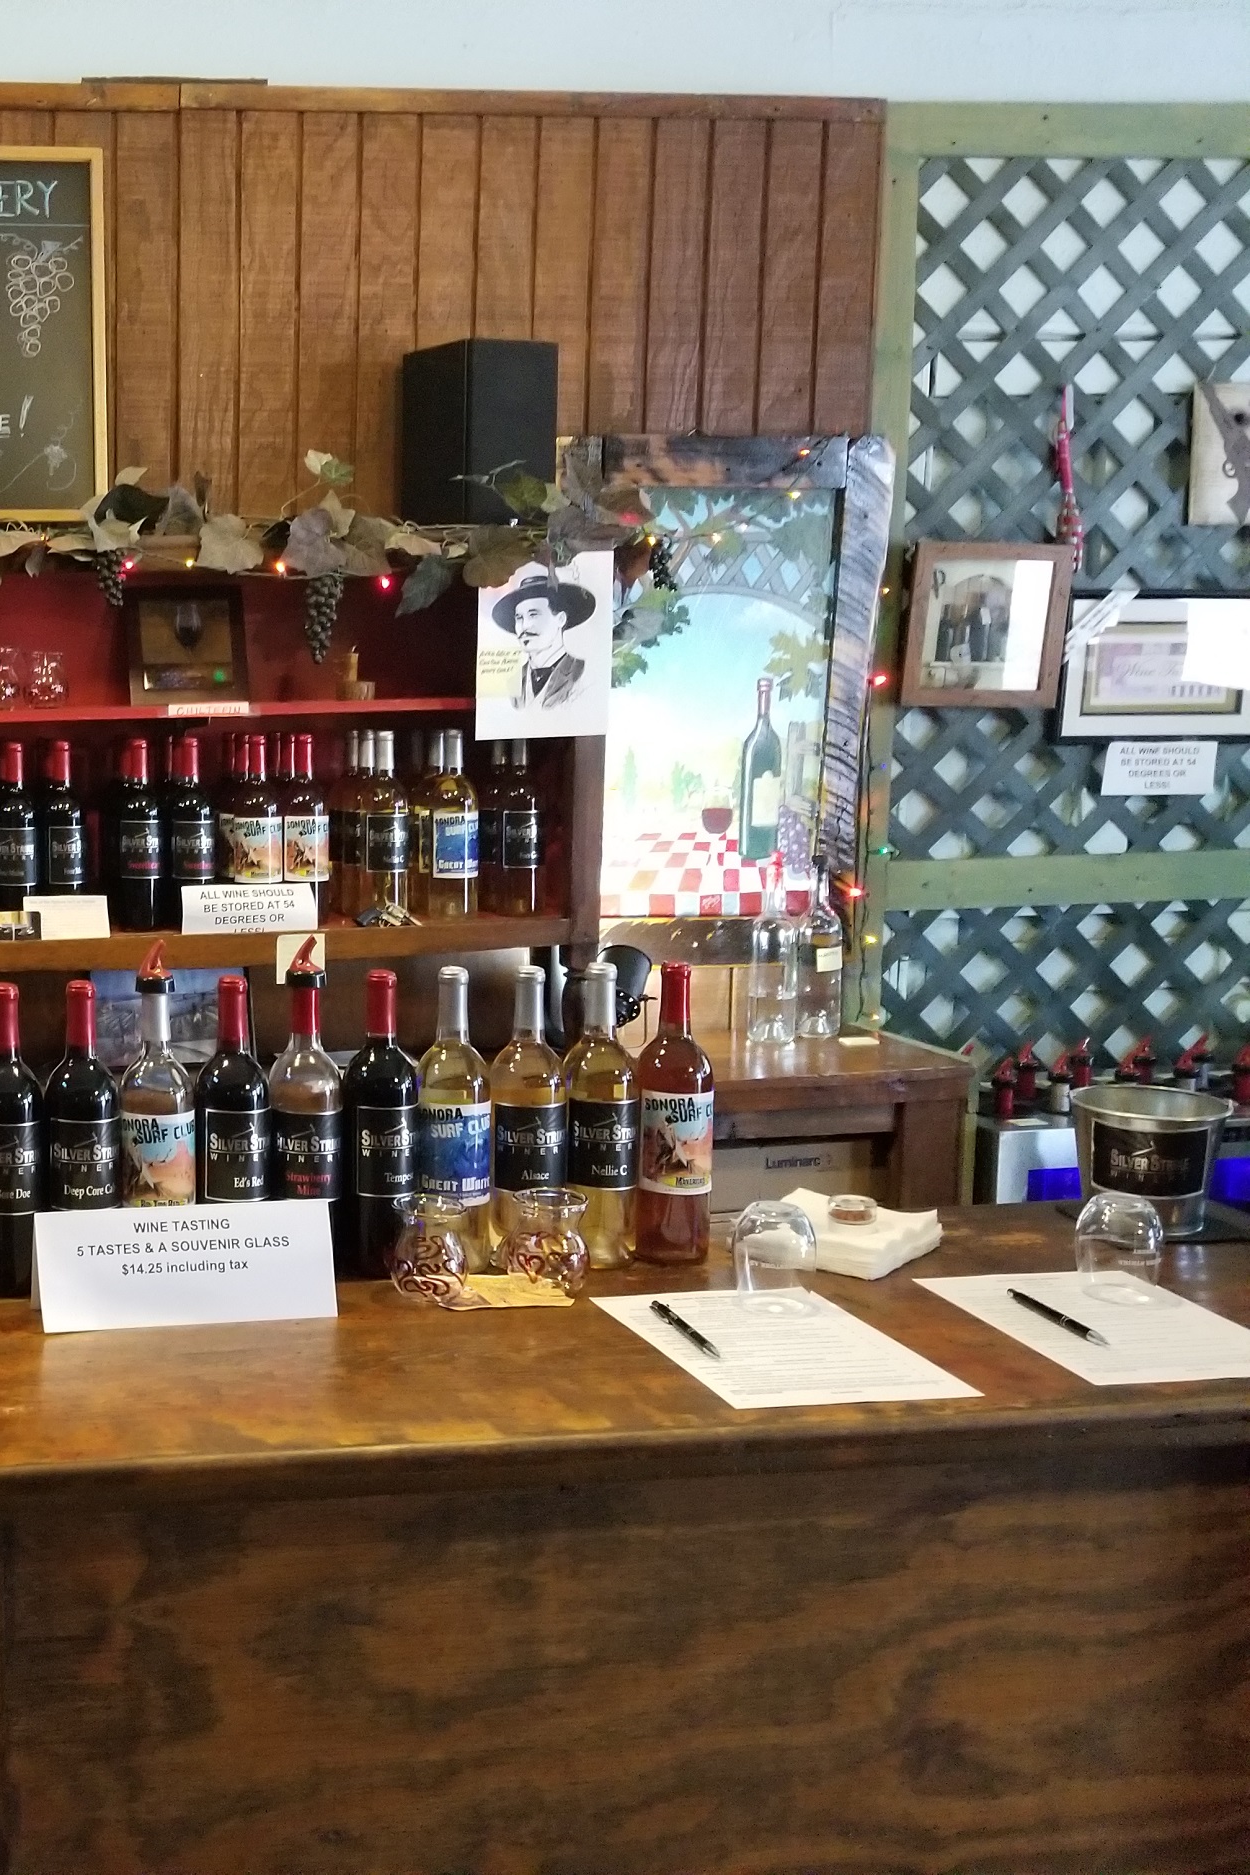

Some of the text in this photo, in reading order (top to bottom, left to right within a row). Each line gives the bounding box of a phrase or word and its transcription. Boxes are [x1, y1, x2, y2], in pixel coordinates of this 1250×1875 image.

[1120, 746, 1200, 755] ALL WINE SHOULD
[1120, 758, 1196, 767] BE STORED AT 54
[1128, 769, 1187, 778] DEGREES OR
[200, 888, 295, 901] ALL WINE SHOULD
[203, 900, 295, 913] BE STORED AT 54
[214, 913, 285, 925] DEGREES OR
[644, 1097, 695, 1112] SONORA
[671, 1107, 702, 1123] SURF
[136, 1128, 169, 1144] SURF
[431, 1121, 464, 1138] SURF
[496, 1124, 534, 1145] SILVER
[573, 1120, 610, 1140] SILVER
[210, 1133, 249, 1151] SILVER
[362, 1129, 400, 1147] SILVER
[53, 1144, 91, 1161] SILVER
[1110, 1148, 1149, 1171] SILVER
[766, 1156, 821, 1169] Luminarc
[285, 1171, 332, 1185] Strawberry
[521, 1169, 550, 1181] Alsace
[591, 1164, 628, 1177] Nellie C
[233, 1176, 264, 1189] Ed's Red
[421, 1174, 459, 1192] GREAT
[15, 1188, 31, 1200] Doe
[63, 1184, 85, 1197] Deep
[86, 1184, 103, 1196] Core
[133, 1218, 231, 1234] WINE TASTING
[77, 1235, 291, 1257] 5 TASTES & A SOUVENIR GLASS
[121, 1258, 249, 1276] $14.25 including tax
